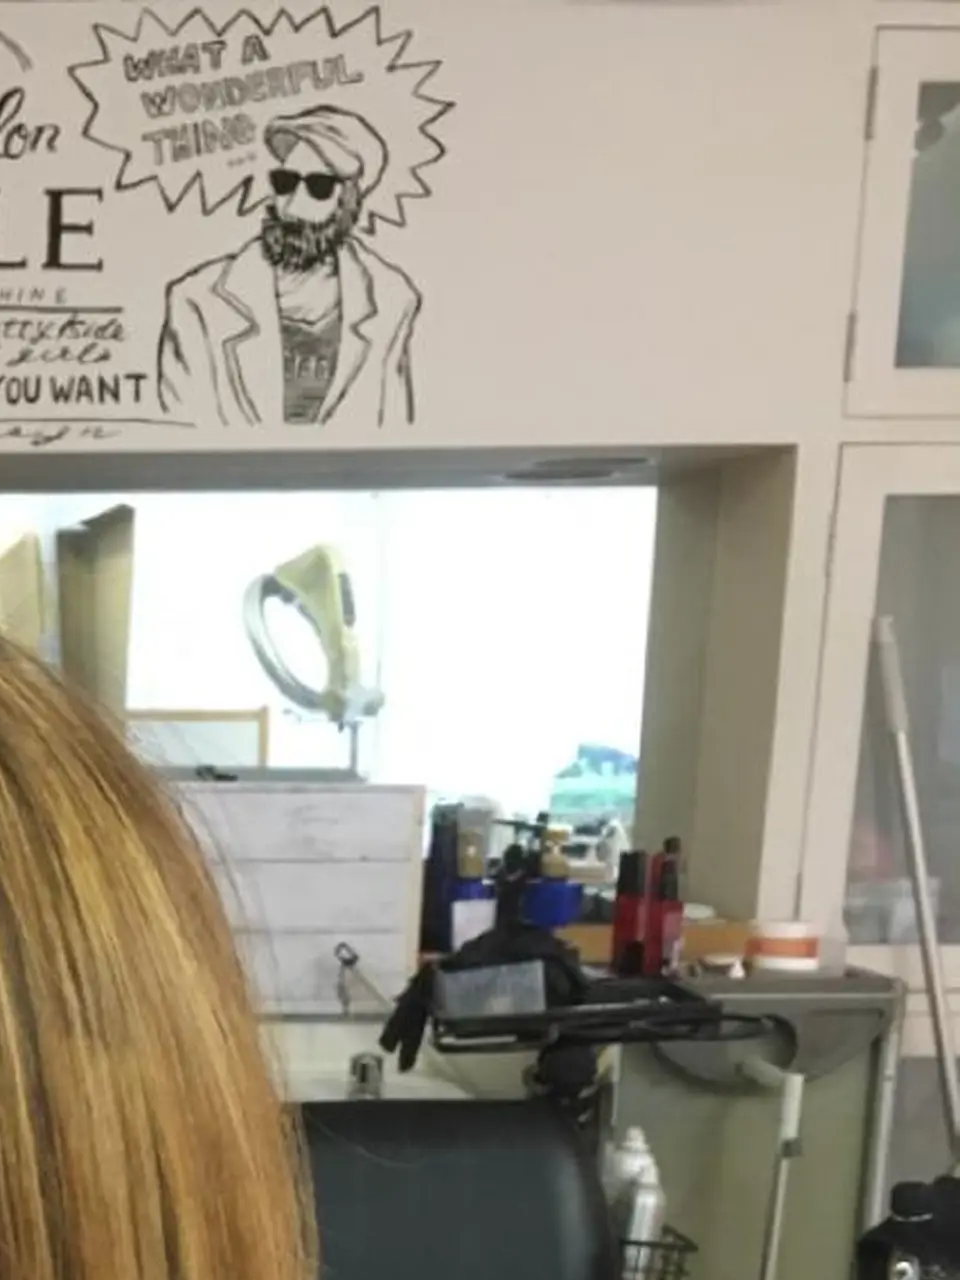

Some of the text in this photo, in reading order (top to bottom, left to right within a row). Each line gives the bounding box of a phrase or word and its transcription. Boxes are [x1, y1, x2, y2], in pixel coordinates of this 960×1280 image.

[123, 34, 270, 82] WHAT A
[141, 54, 364, 119] WONDERFUL
[48, 371, 148, 406] WANT
